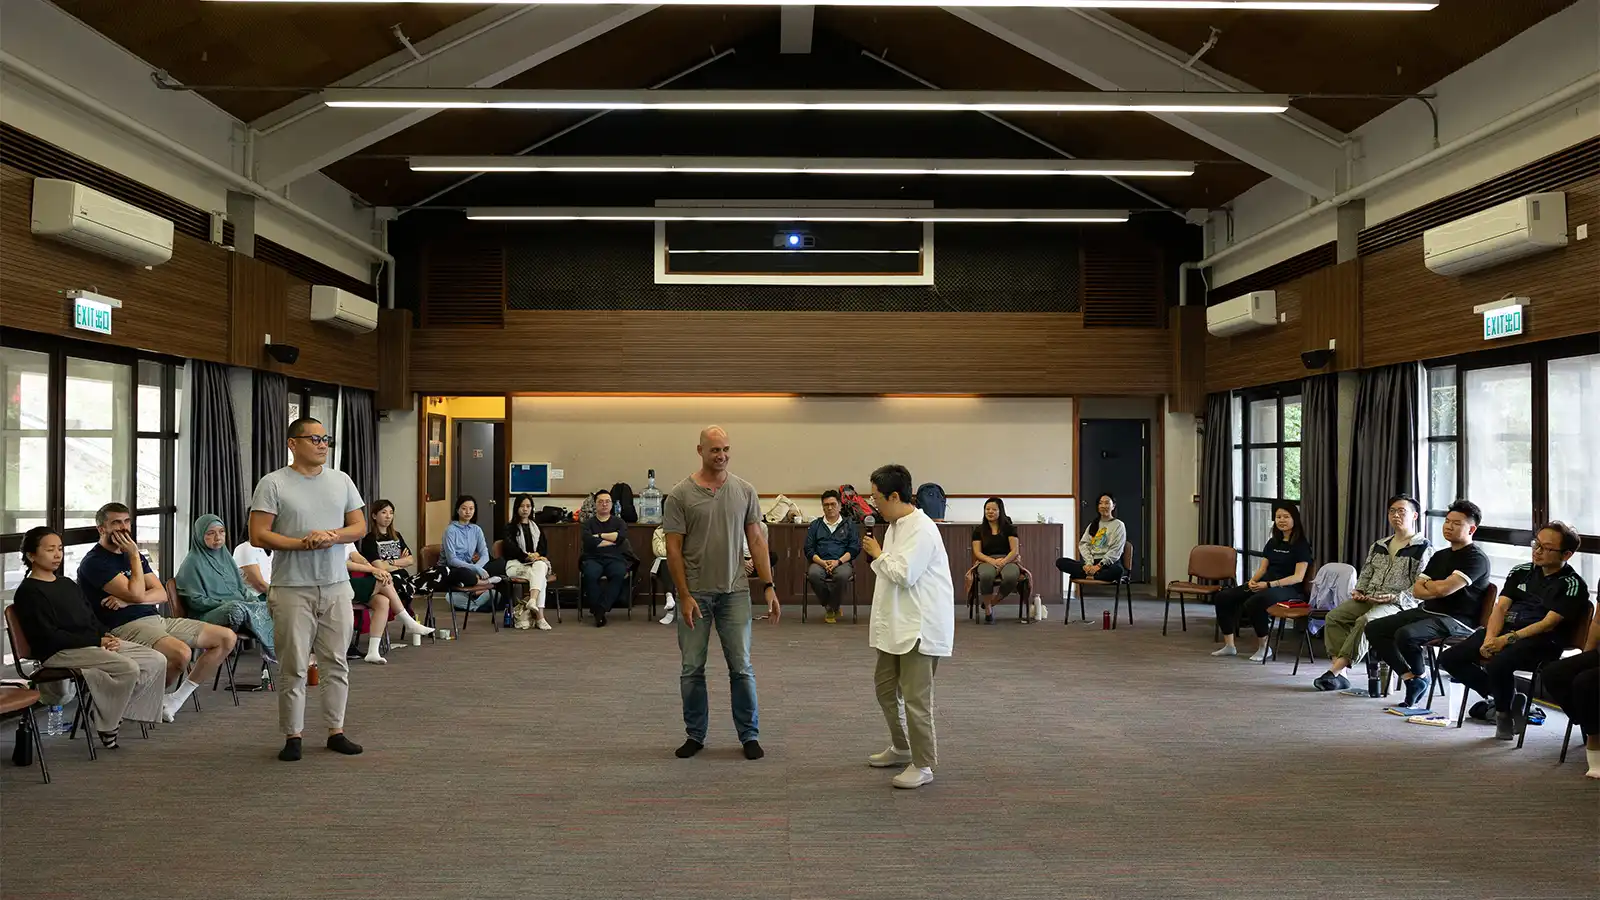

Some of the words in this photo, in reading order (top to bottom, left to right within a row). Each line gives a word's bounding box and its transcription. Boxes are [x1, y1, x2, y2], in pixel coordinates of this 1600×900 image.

[76, 304, 95, 327] EXIT
[95, 310, 110, 331] 出口
[1486, 314, 1504, 337] EXIT
[1505, 311, 1521, 333] 出口
